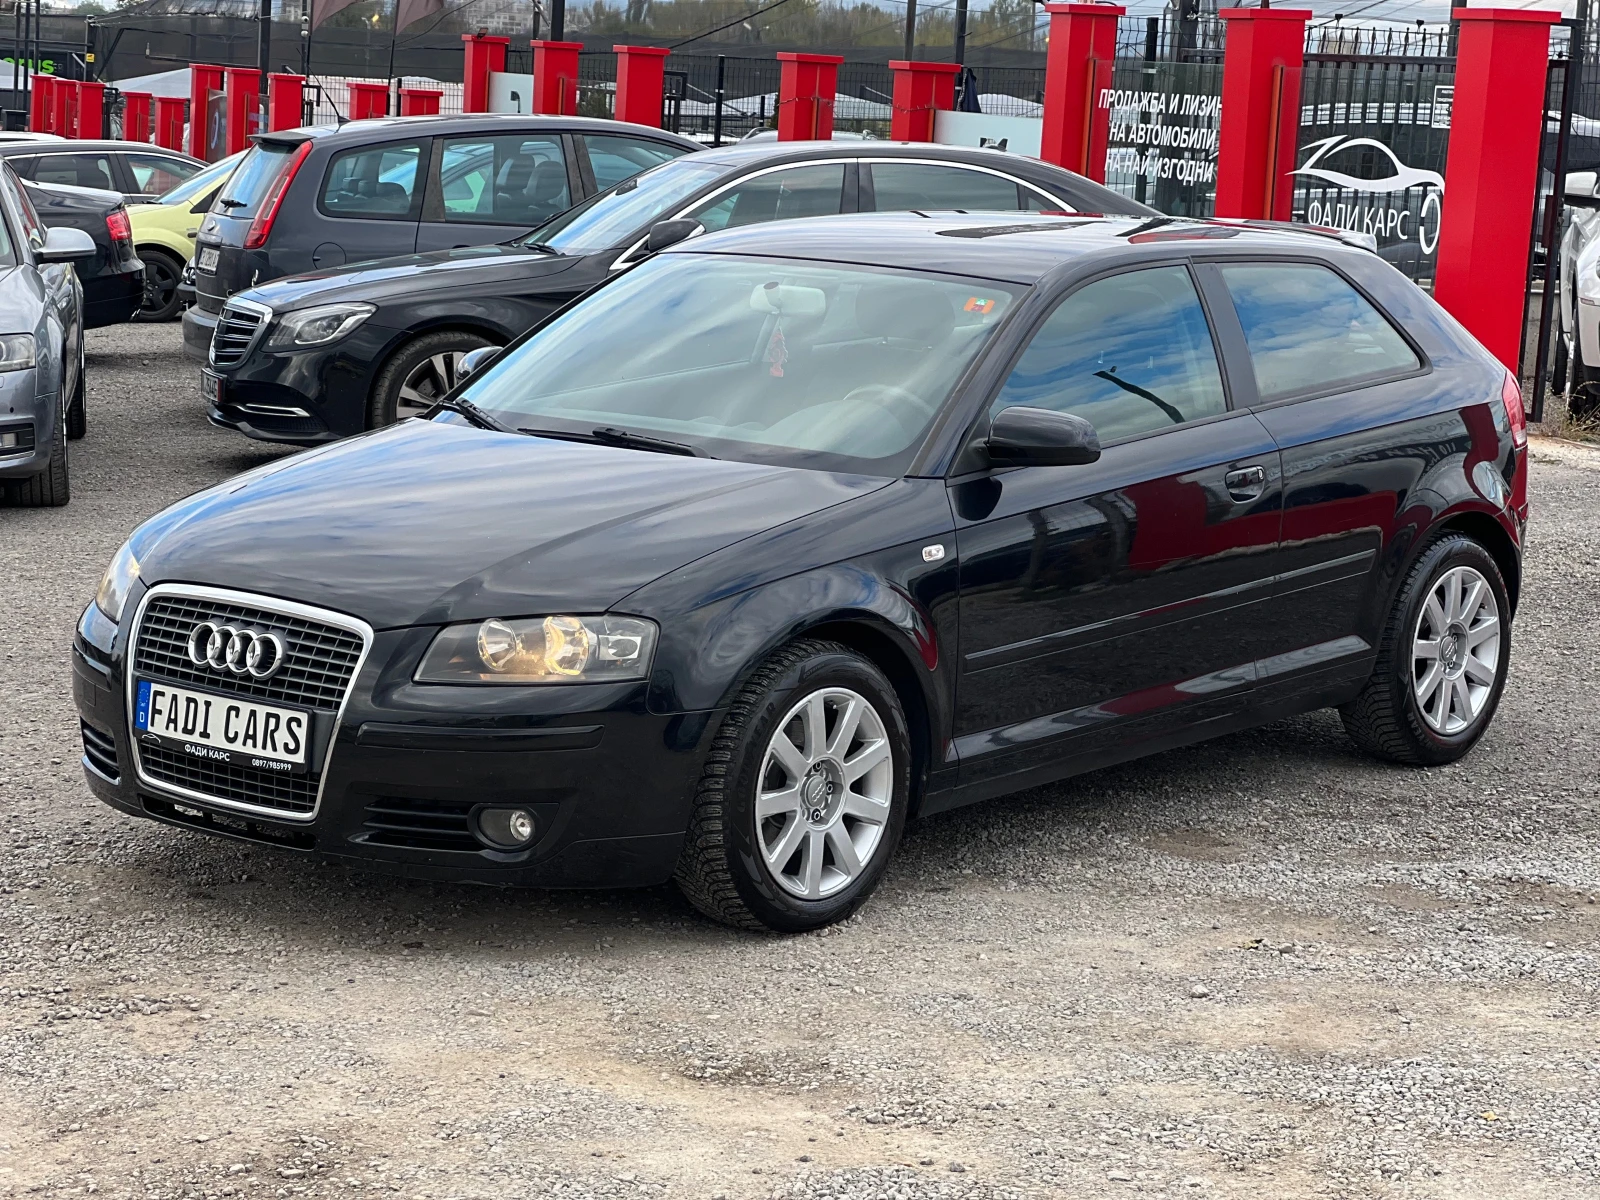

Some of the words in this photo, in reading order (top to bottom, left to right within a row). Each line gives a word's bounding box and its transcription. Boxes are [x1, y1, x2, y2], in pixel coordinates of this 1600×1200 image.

[1098, 89, 1165, 115] ПРОДАЖБА
[1168, 93, 1180, 115] И
[1108, 120, 1126, 142] НА
[1127, 123, 1217, 150] АВТОМОБИЛИ
[1104, 150, 1121, 173] НА
[1363, 206, 1410, 240] КАРС
[139, 711, 145, 723] D
[150, 690, 212, 739] FADI
[224, 705, 302, 755] CARS
[184, 743, 208, 757] ФАДИ
[208, 748, 230, 762] КАРС
[251, 758, 292, 771] 0897/985999
